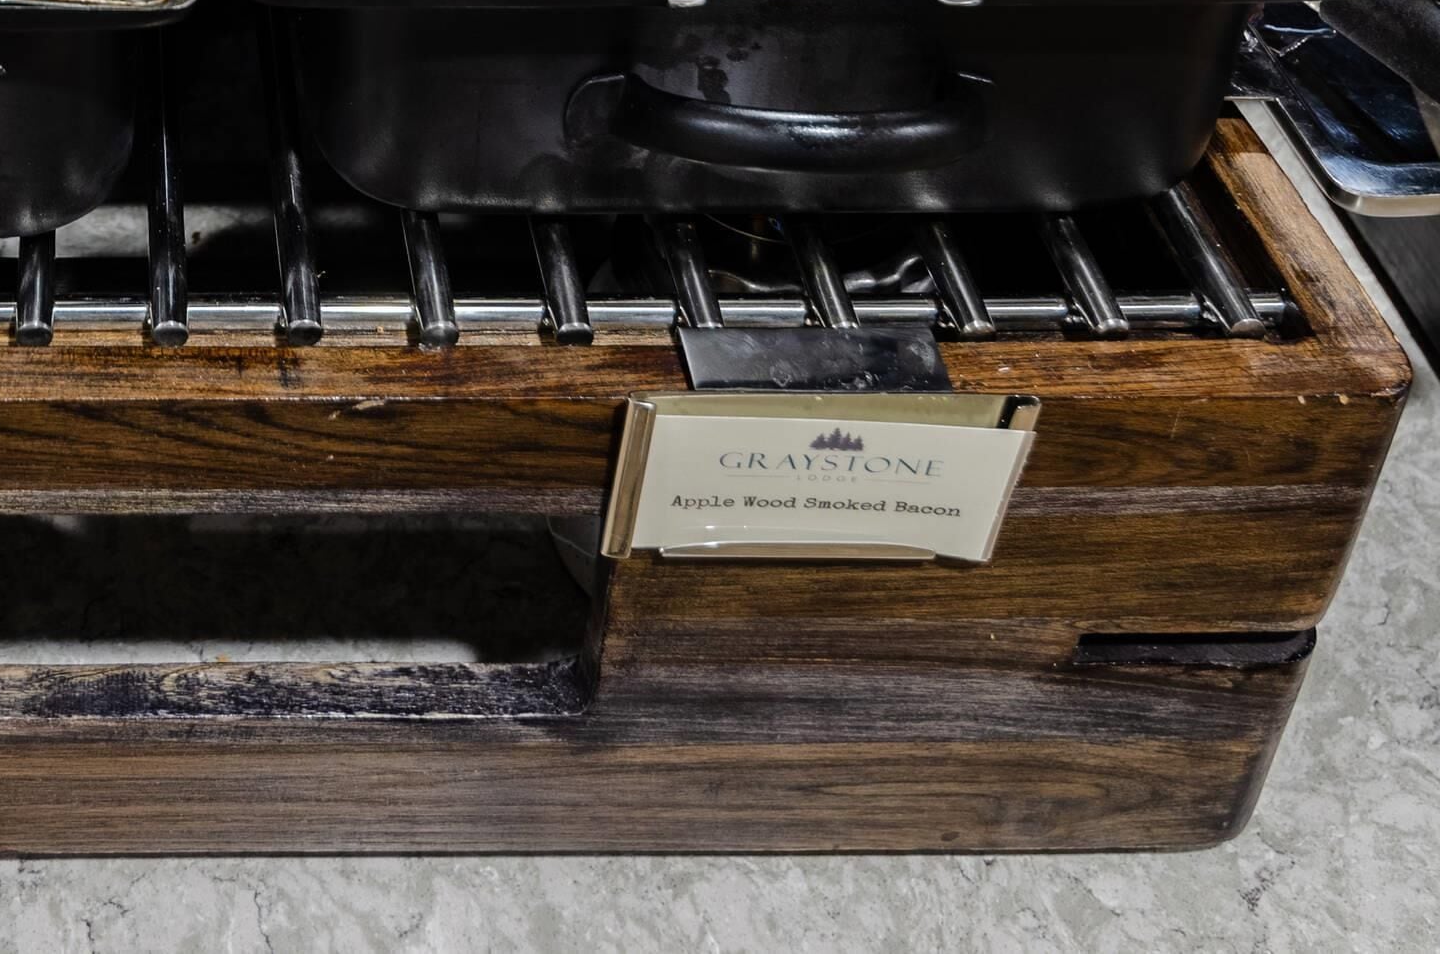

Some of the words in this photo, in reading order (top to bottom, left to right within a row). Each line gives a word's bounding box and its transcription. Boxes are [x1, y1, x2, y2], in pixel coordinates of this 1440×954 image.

[718, 451, 945, 477] GRAYSTONE
[671, 495, 735, 510] Apple
[743, 496, 796, 510] Wood
[803, 497, 887, 513] Smoked
[894, 501, 961, 517] Bacon
